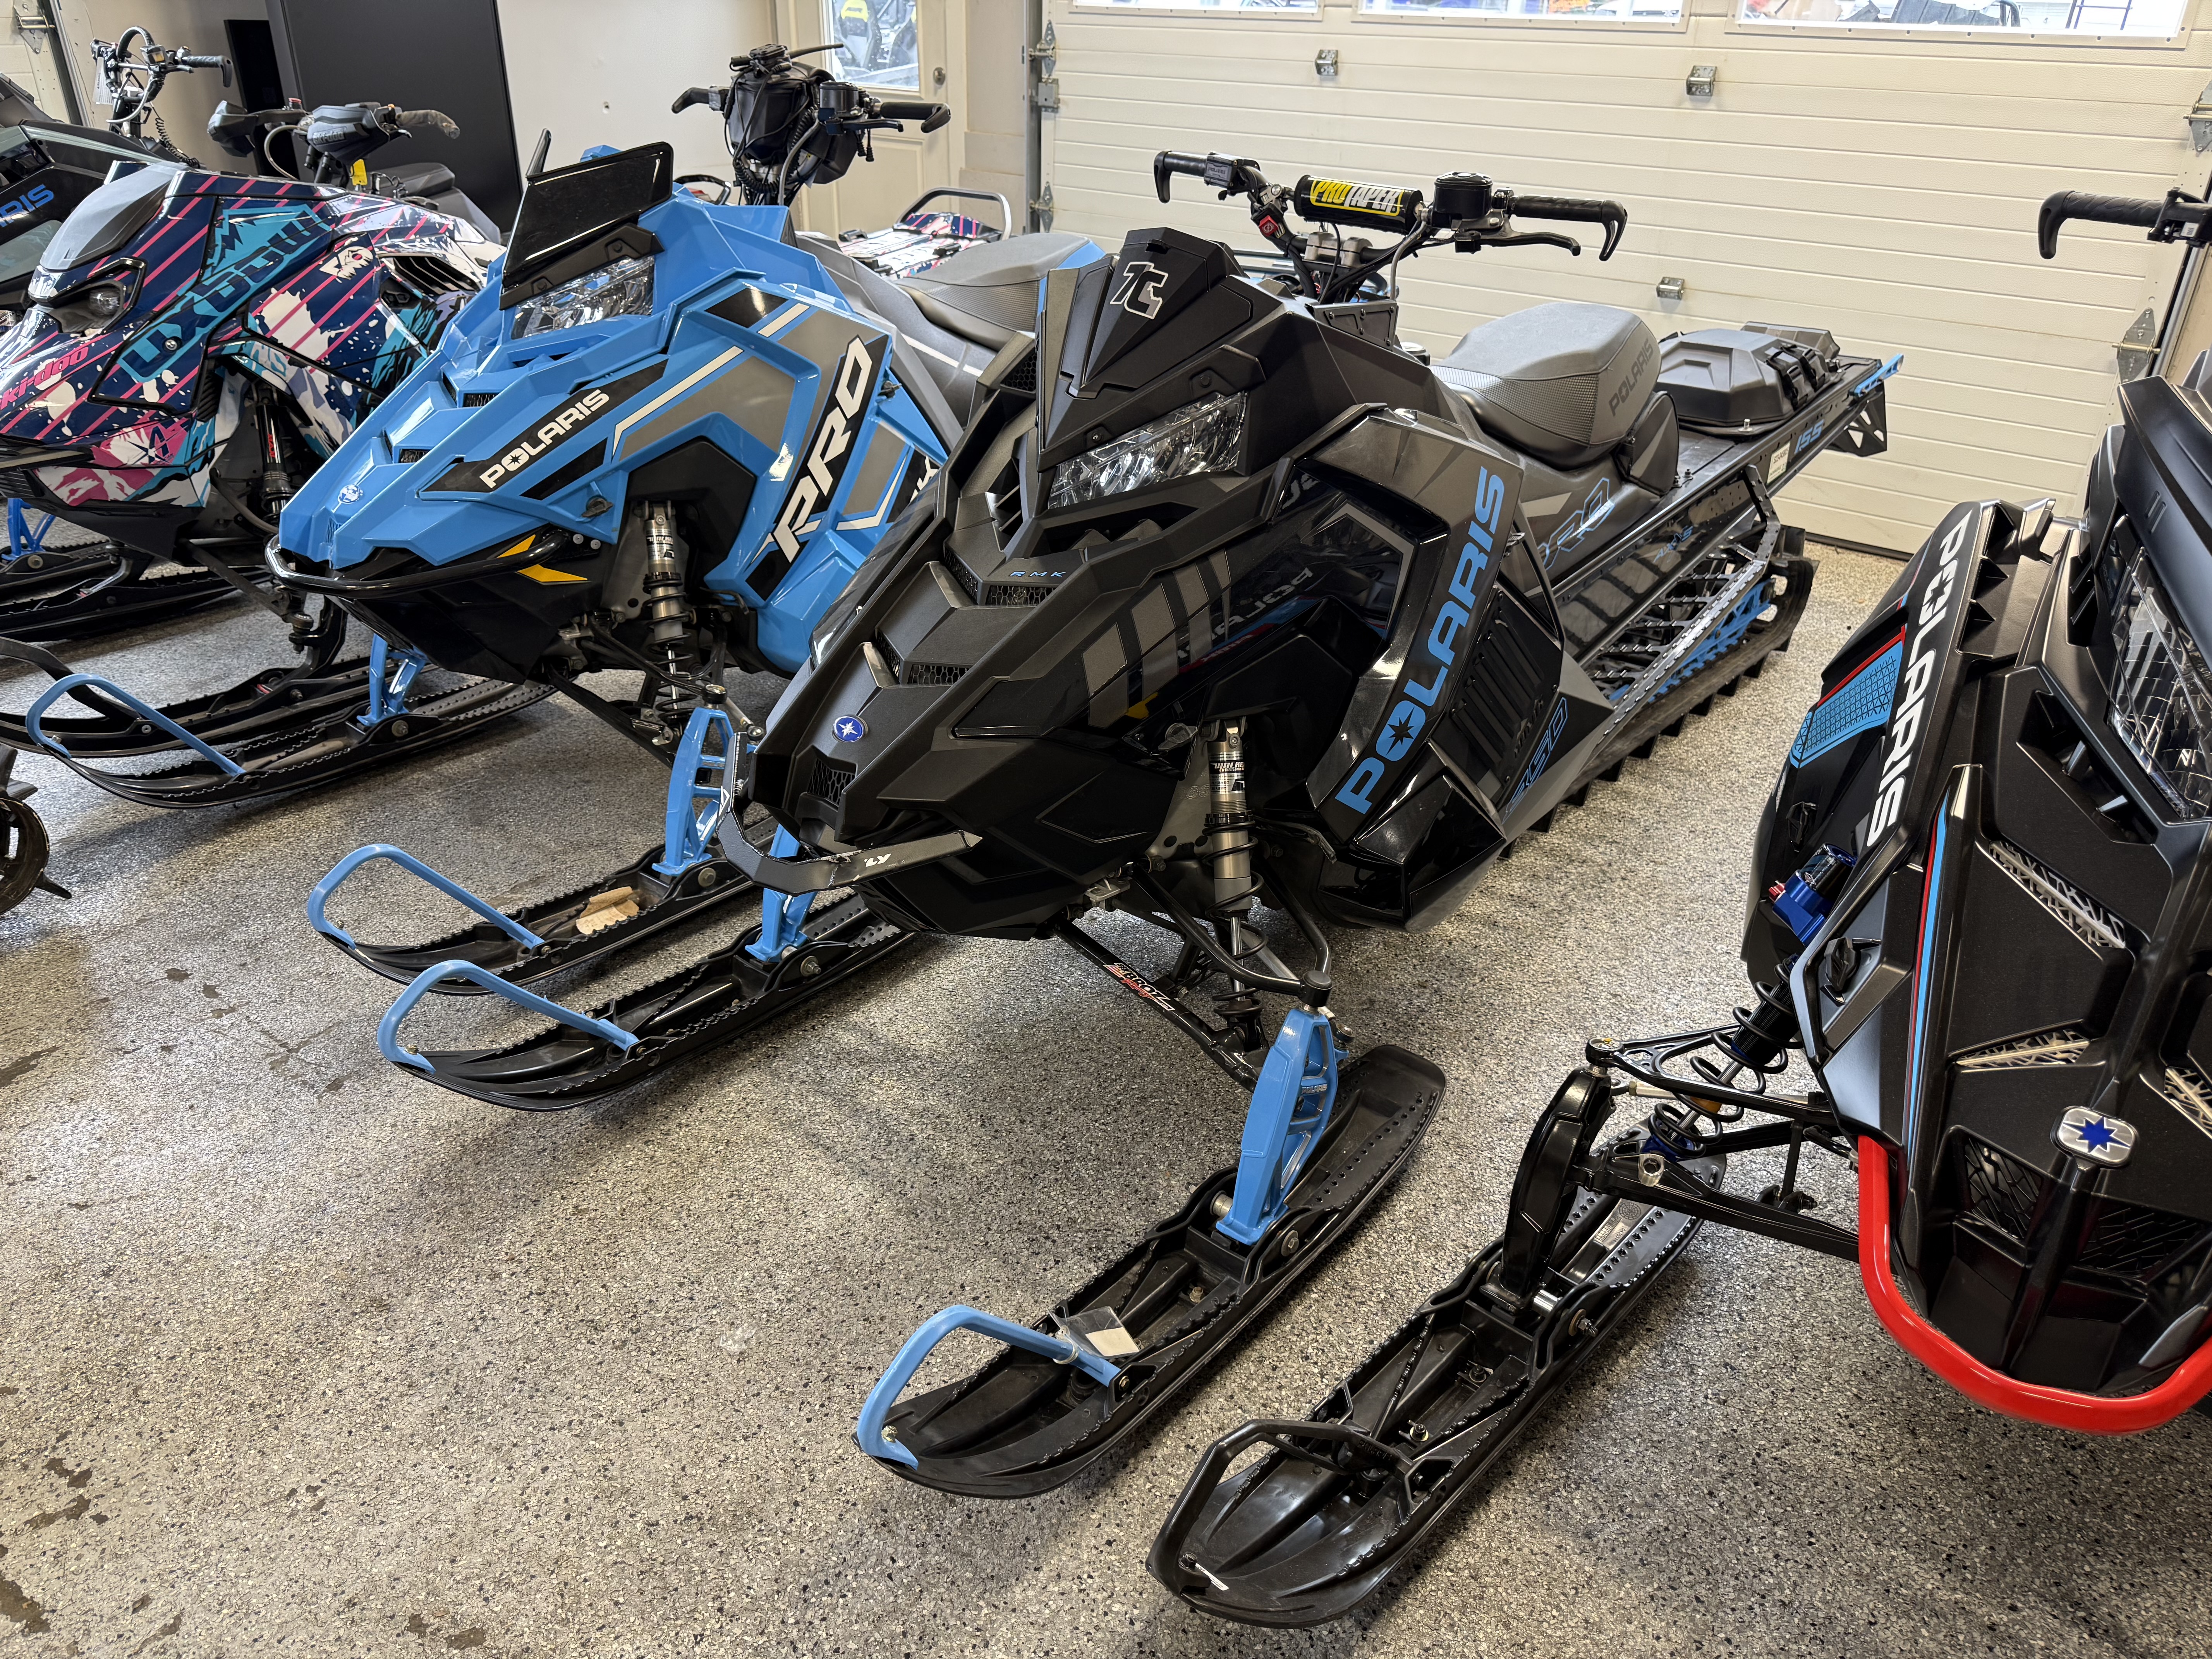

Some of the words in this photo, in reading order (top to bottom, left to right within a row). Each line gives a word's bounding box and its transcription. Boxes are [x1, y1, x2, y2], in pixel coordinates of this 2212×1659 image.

[1608, 338, 1654, 417] POLARIS
[479, 389, 610, 489] POLARIS
[1794, 419, 1824, 455] 155
[1335, 466, 1504, 814] POLARIS
[1867, 510, 1972, 848] POLARIS
[1502, 698, 1568, 825] 850
[1302, 1084, 1328, 1094] POLARIS
